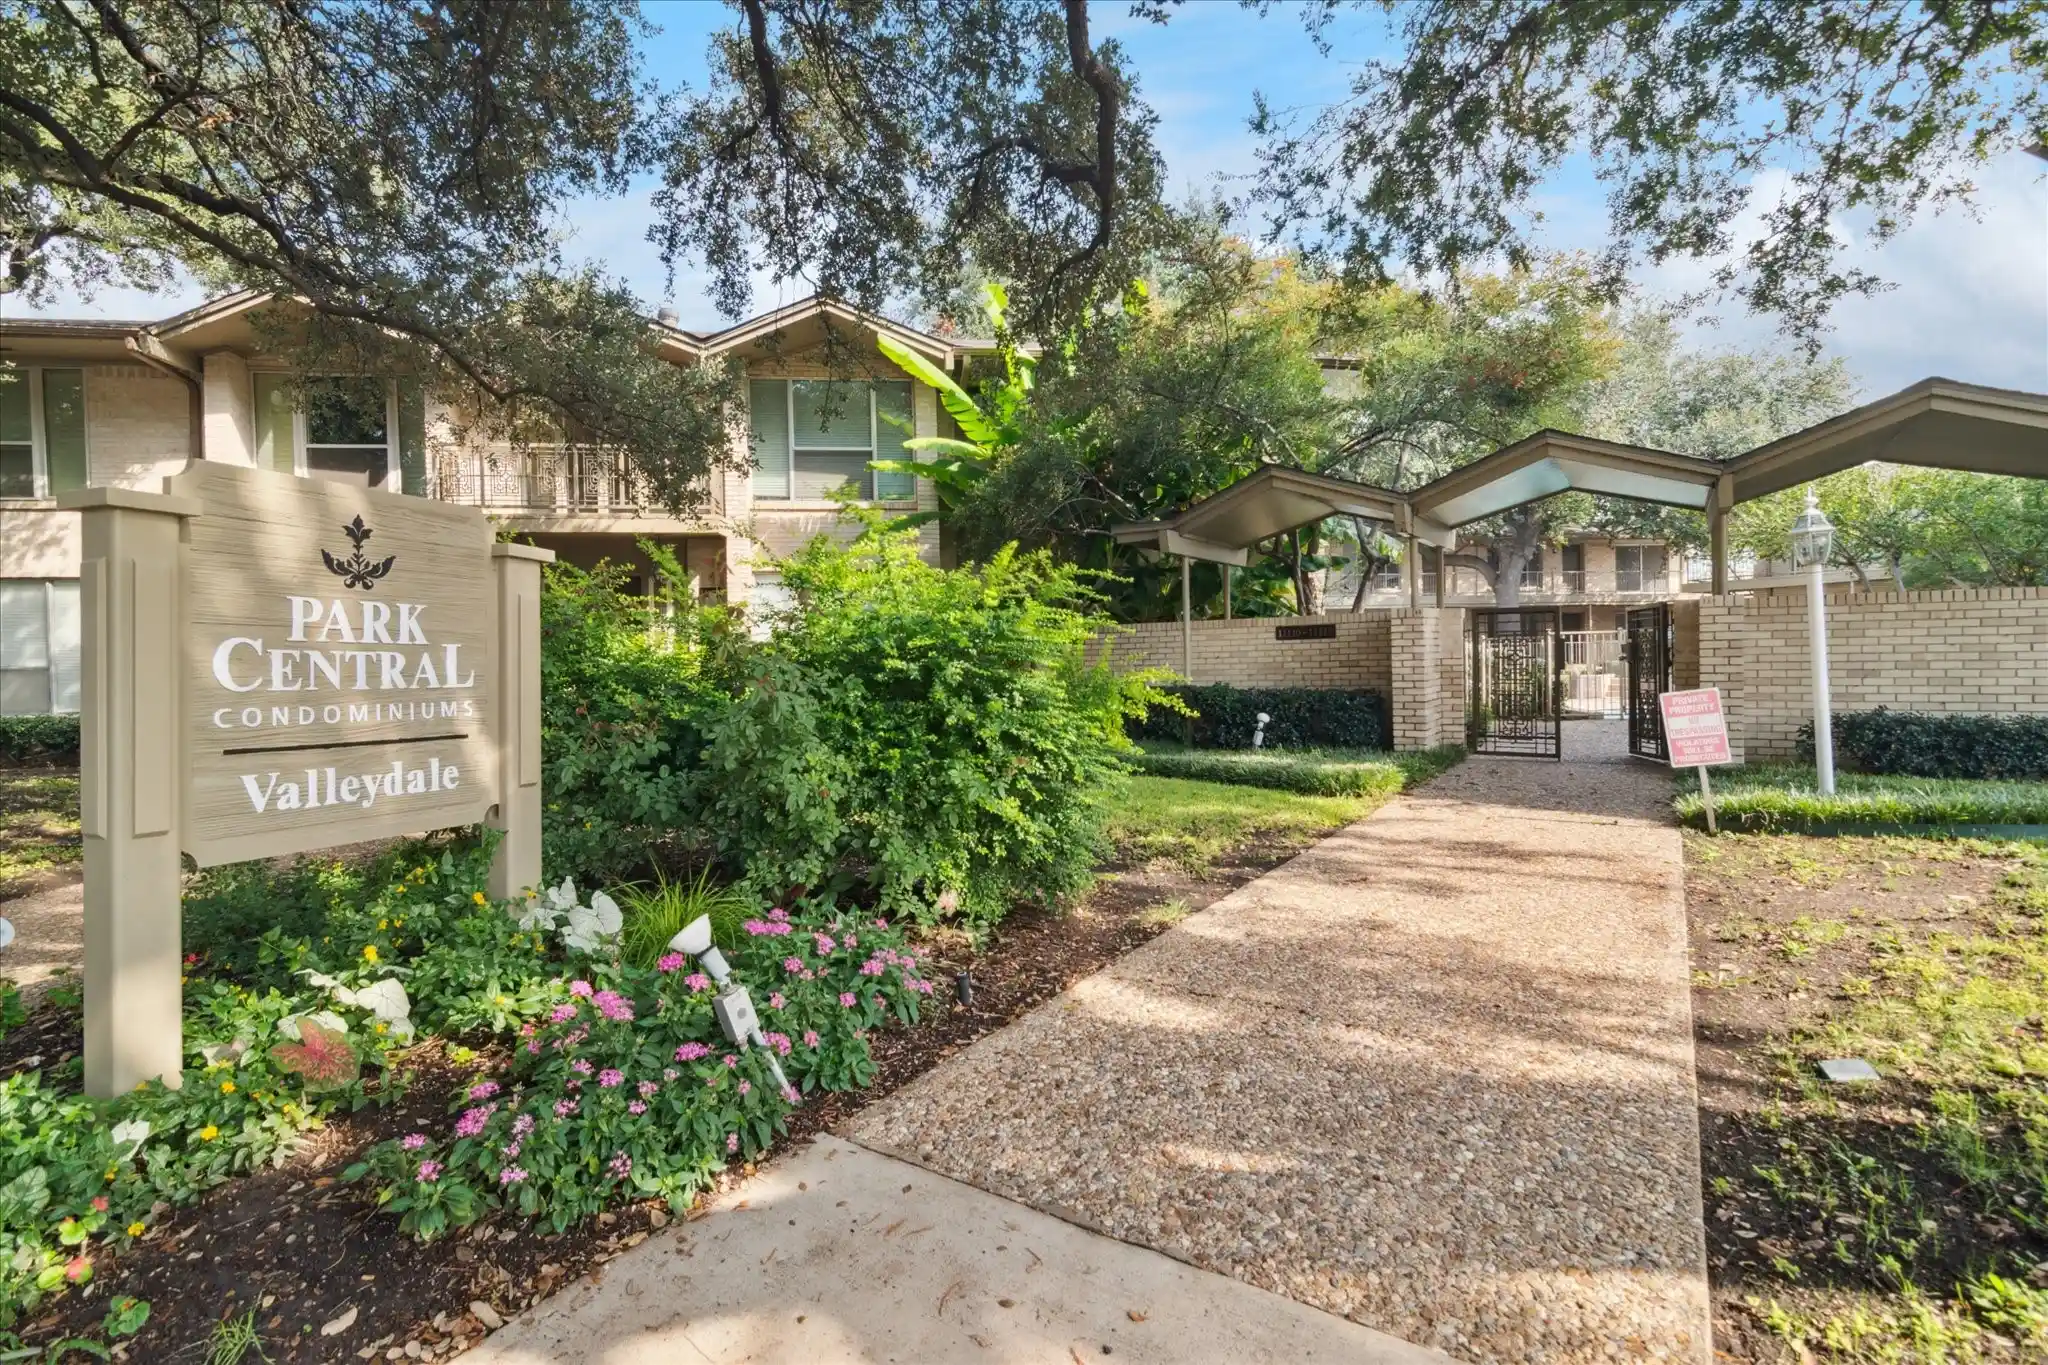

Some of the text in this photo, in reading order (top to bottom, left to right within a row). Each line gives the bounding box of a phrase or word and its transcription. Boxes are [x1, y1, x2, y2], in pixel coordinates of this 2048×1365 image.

[286, 596, 430, 645] PARK
[212, 637, 476, 692] CENTRAL
[213, 700, 474, 729] CONDOMINIUMS
[1668, 703, 1716, 714] PROPERTY
[1672, 694, 1710, 706] PRIVATE
[239, 757, 460, 814] Valleydale
